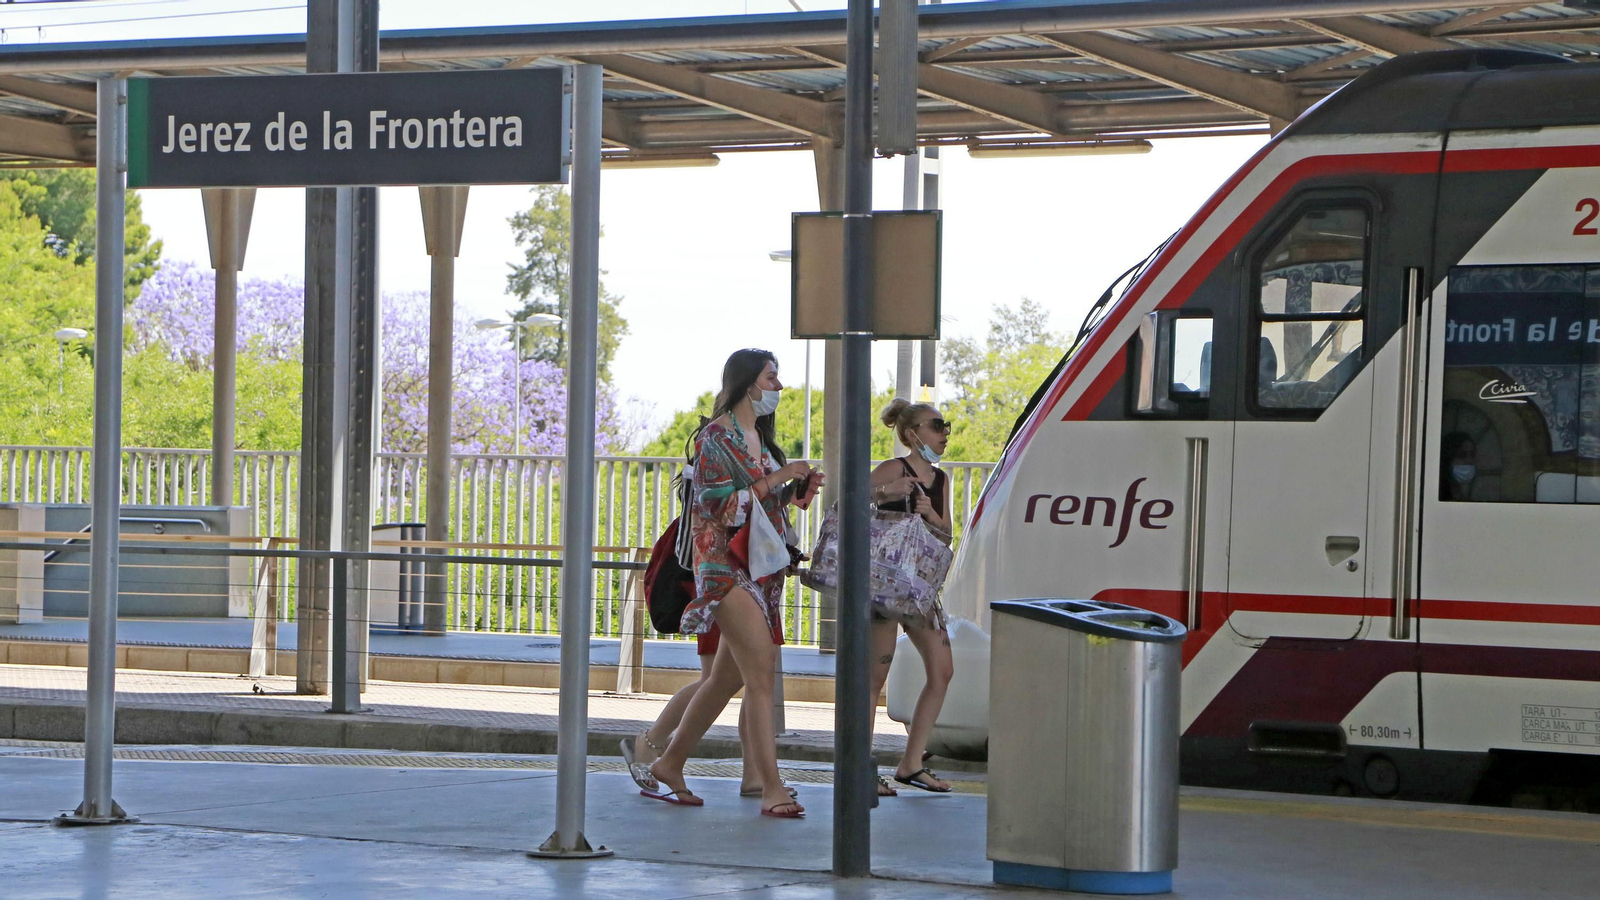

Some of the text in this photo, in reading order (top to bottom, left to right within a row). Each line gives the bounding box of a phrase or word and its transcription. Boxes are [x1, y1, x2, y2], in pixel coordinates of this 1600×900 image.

[162, 109, 523, 153] Jerez de la Frontera
[1572, 197, 1600, 236] 2
[1024, 477, 1174, 548] renfe
[1523, 706, 1546, 717] TARA
[1360, 725, 1400, 740] 80,30m
[1523, 730, 1552, 742] CARGA
